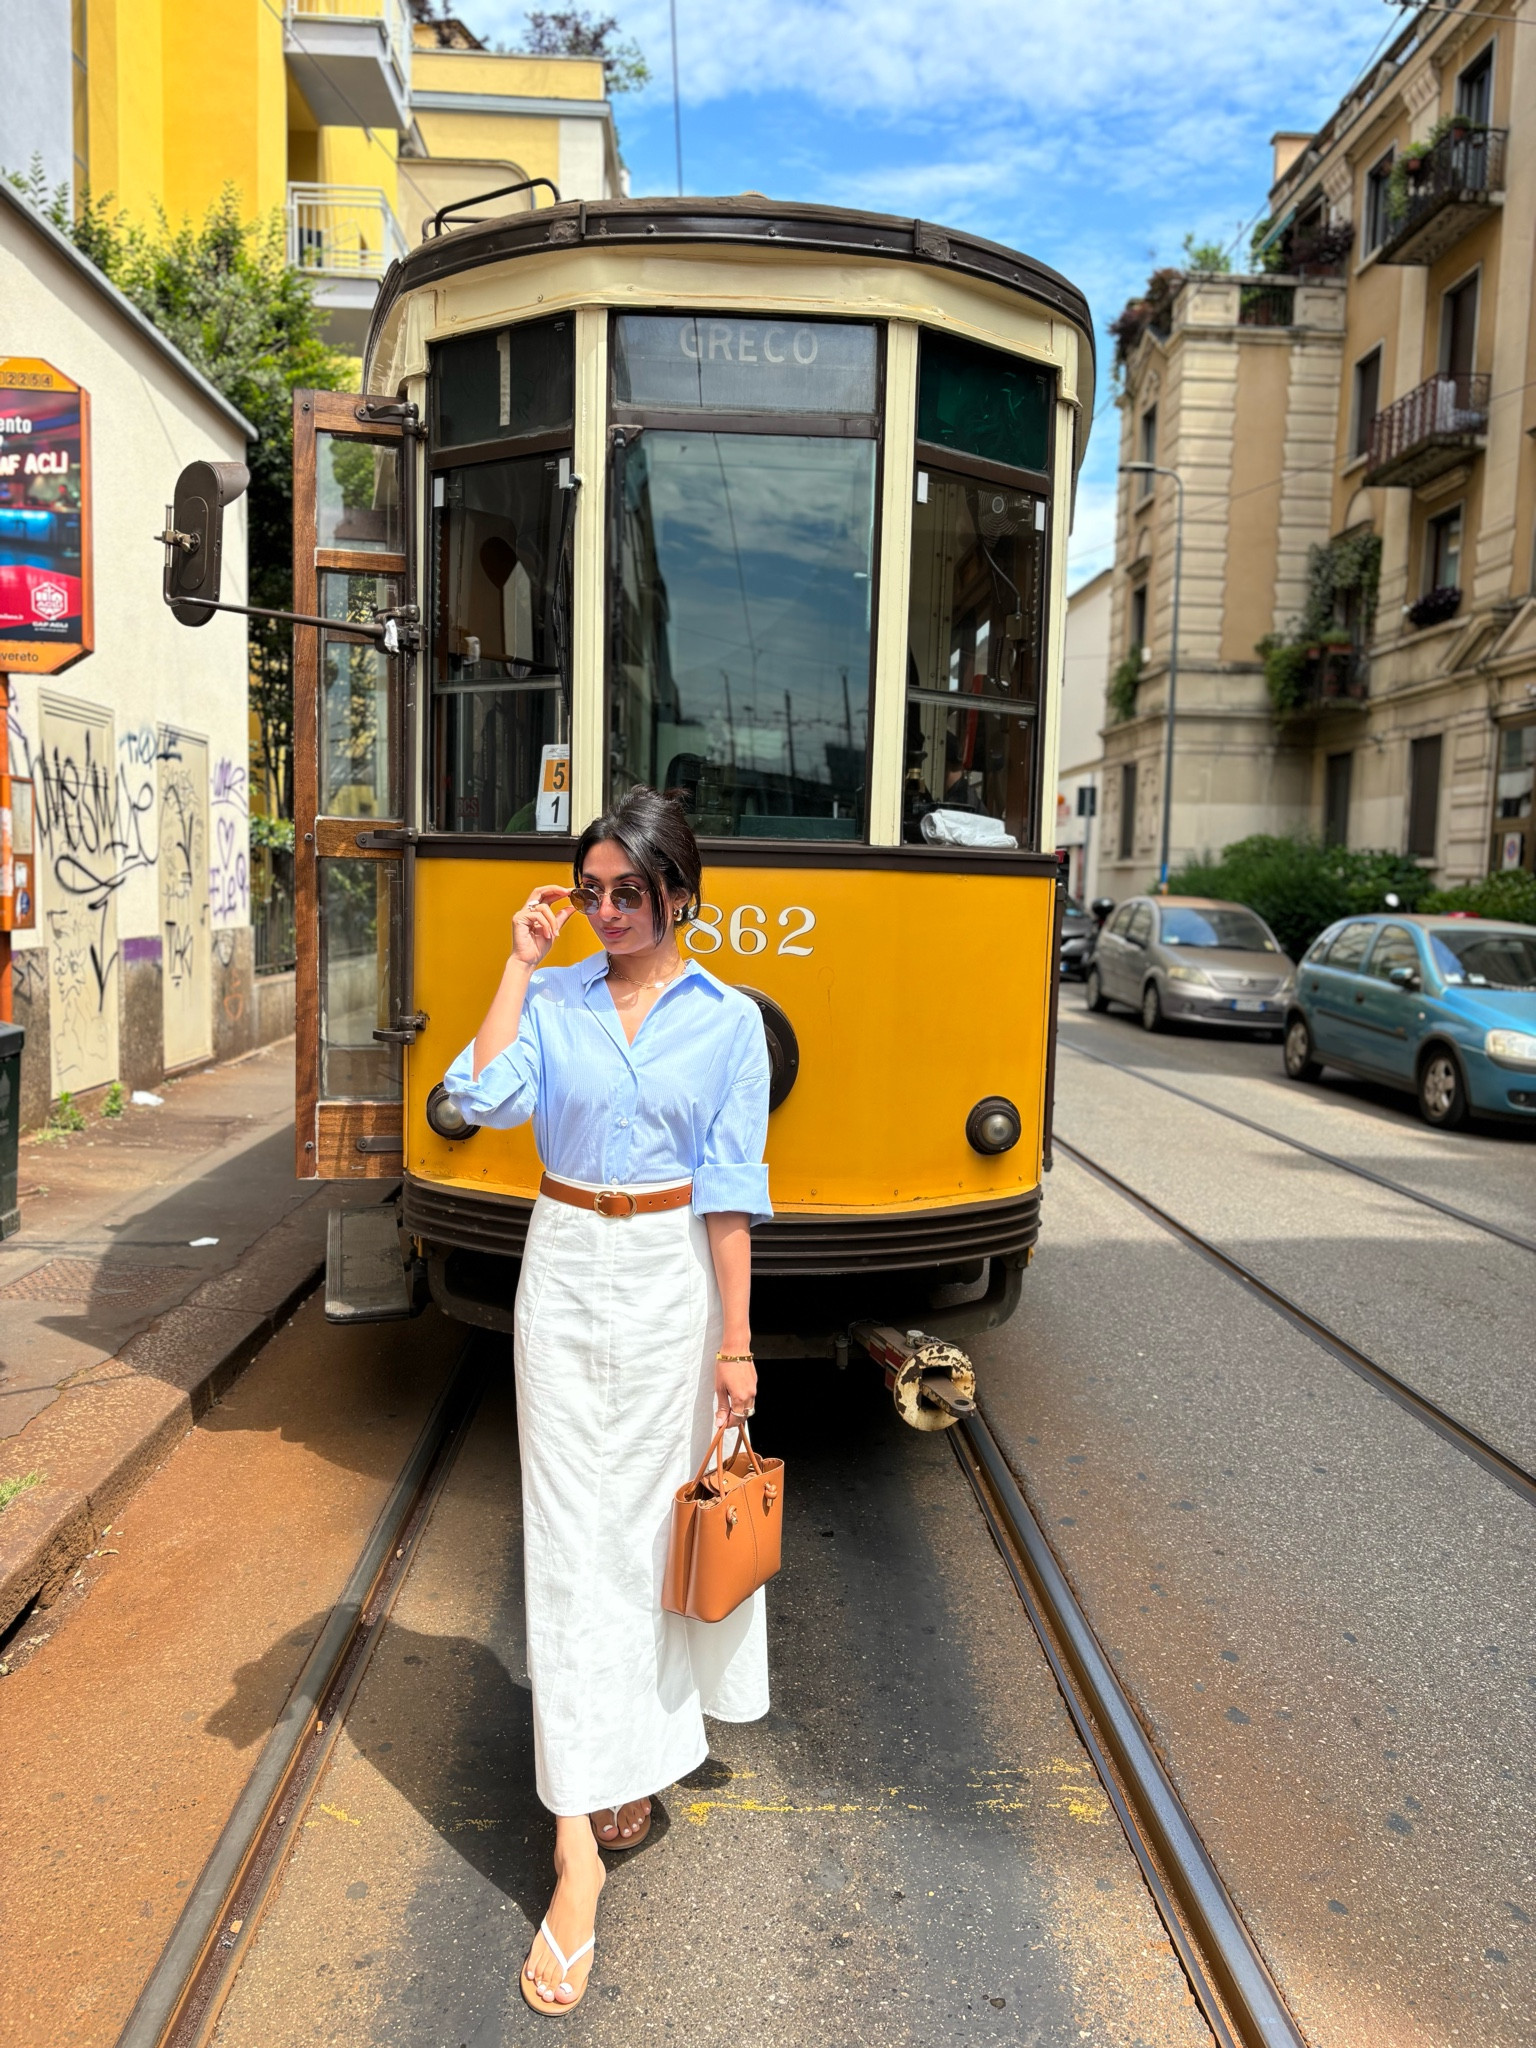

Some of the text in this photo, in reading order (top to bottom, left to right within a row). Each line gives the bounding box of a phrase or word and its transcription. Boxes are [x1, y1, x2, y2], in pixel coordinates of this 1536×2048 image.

[680, 320, 818, 365] GRECO
[0, 374, 50, 387] 2254
[24, 450, 69, 475] ACLI
[553, 762, 566, 790] 5
[551, 795, 560, 824] 1
[684, 903, 817, 957] 862
